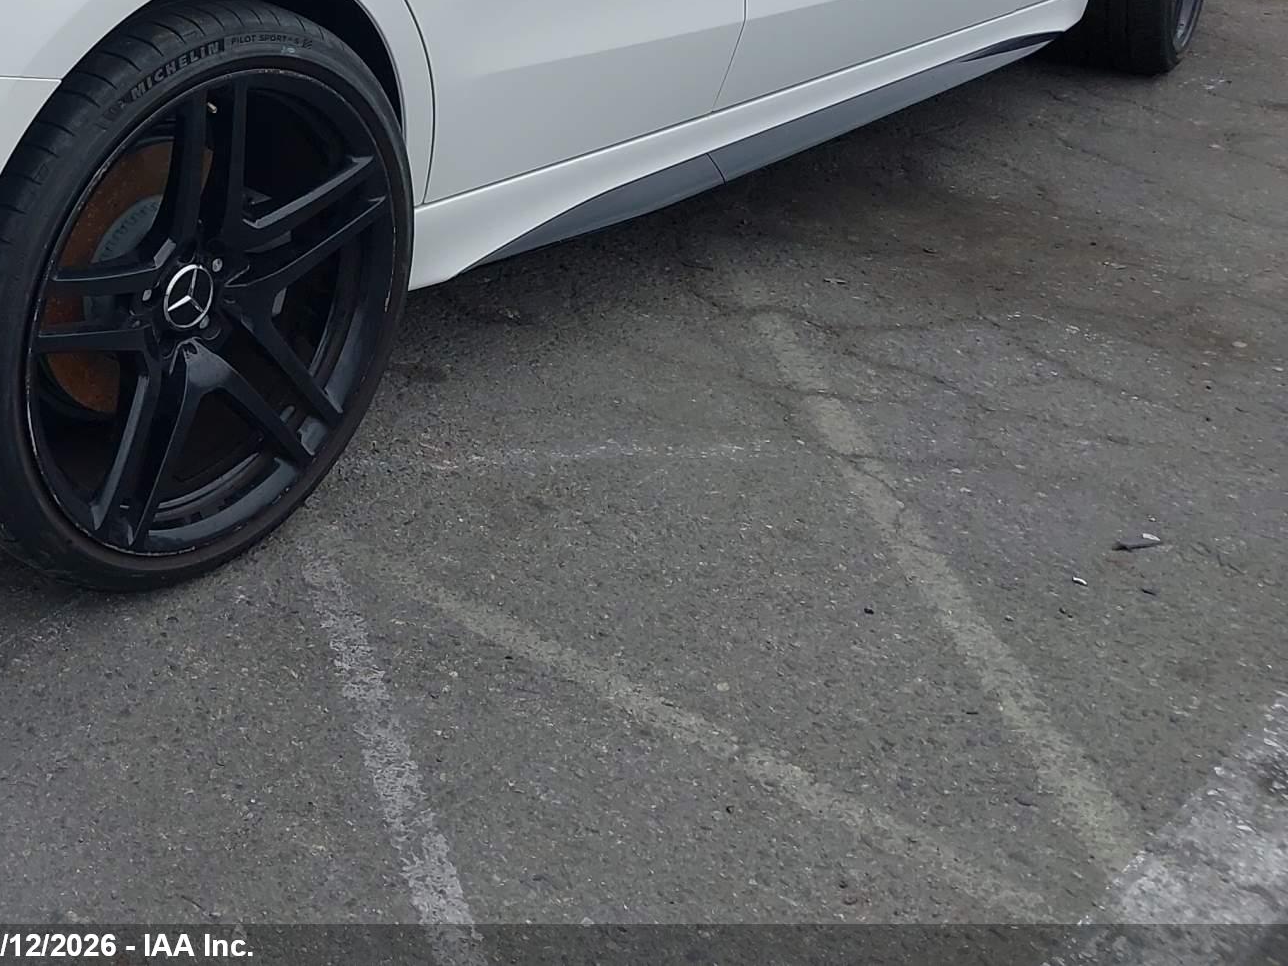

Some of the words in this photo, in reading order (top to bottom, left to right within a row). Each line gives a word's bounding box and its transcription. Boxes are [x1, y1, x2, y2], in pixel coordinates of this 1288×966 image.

[130, 40, 221, 101] MICHELIN
[232, 34, 256, 44] PILOT
[258, 34, 287, 43] SPORT
